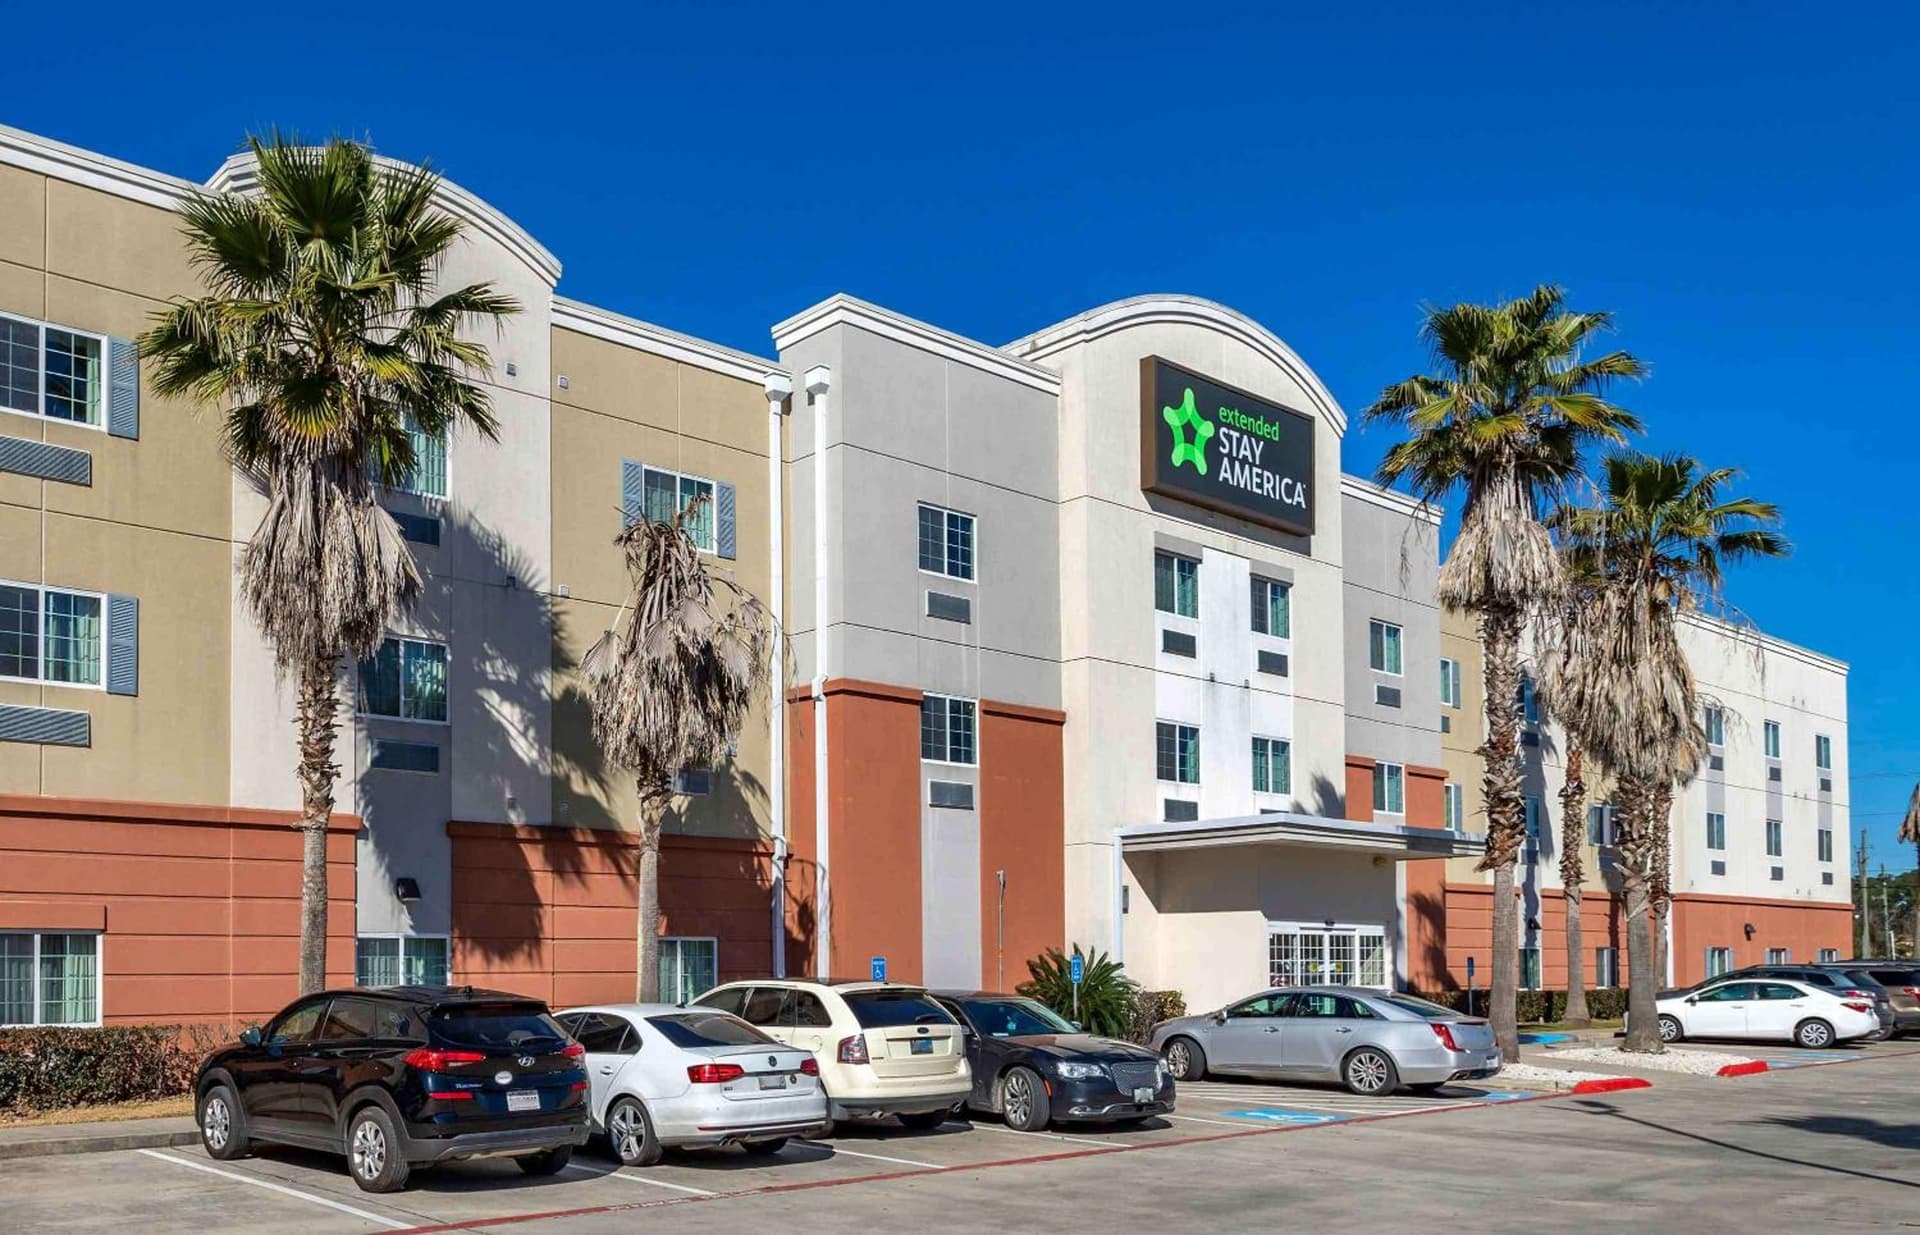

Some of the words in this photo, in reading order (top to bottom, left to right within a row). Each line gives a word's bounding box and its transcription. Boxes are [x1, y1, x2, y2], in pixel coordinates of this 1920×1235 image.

[1219, 407, 1279, 440] extended
[1219, 427, 1264, 465] STAY
[1219, 456, 1306, 509] AMERICA
